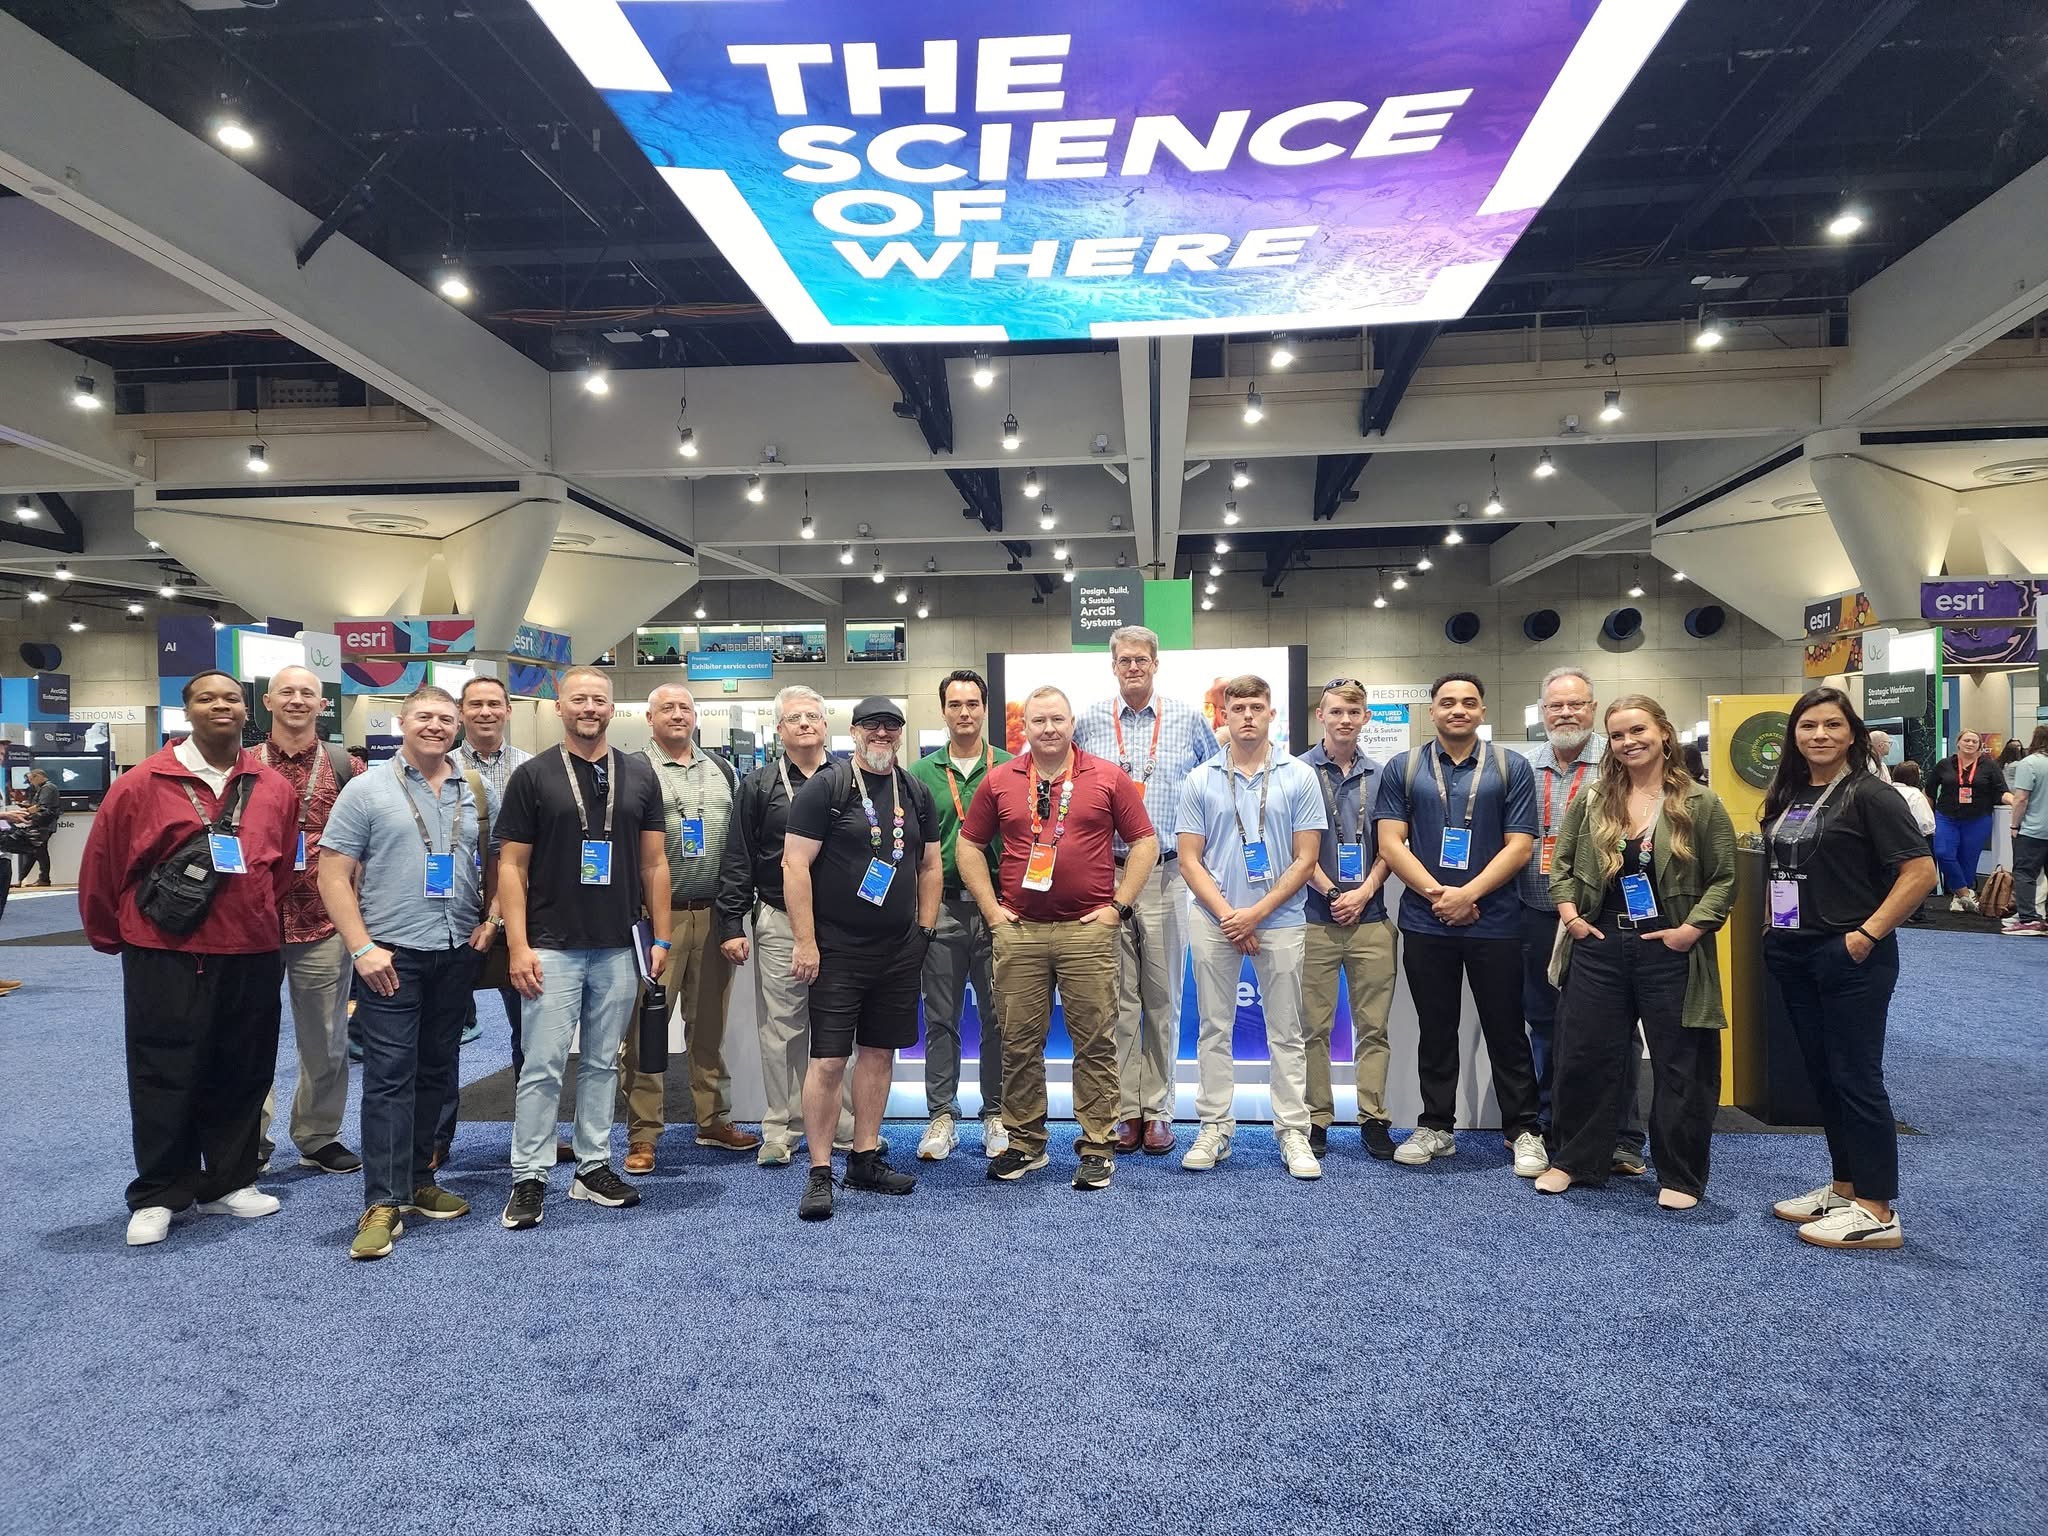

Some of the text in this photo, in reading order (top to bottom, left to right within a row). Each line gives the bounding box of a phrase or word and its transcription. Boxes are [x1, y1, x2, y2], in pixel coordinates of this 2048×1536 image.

[727, 34, 1071, 116] THE
[779, 88, 1475, 186] SCIENCE
[811, 188, 1003, 239] OF
[830, 225, 1319, 281] WHERE
[1080, 586, 1129, 596] Design, Build,
[1935, 587, 1985, 612] esri
[1080, 606, 1116, 616] ArcGIS
[1810, 606, 1831, 630] esri
[1080, 618, 1122, 629] Systems
[346, 626, 387, 648] esri
[514, 632, 533, 651] esri
[164, 642, 176, 652] AI
[1868, 685, 1915, 698] Strategic Workforce
[1868, 696, 1900, 707] Development
[70, 711, 123, 722] ESTROOMS
[1363, 735, 1398, 744] Systems
